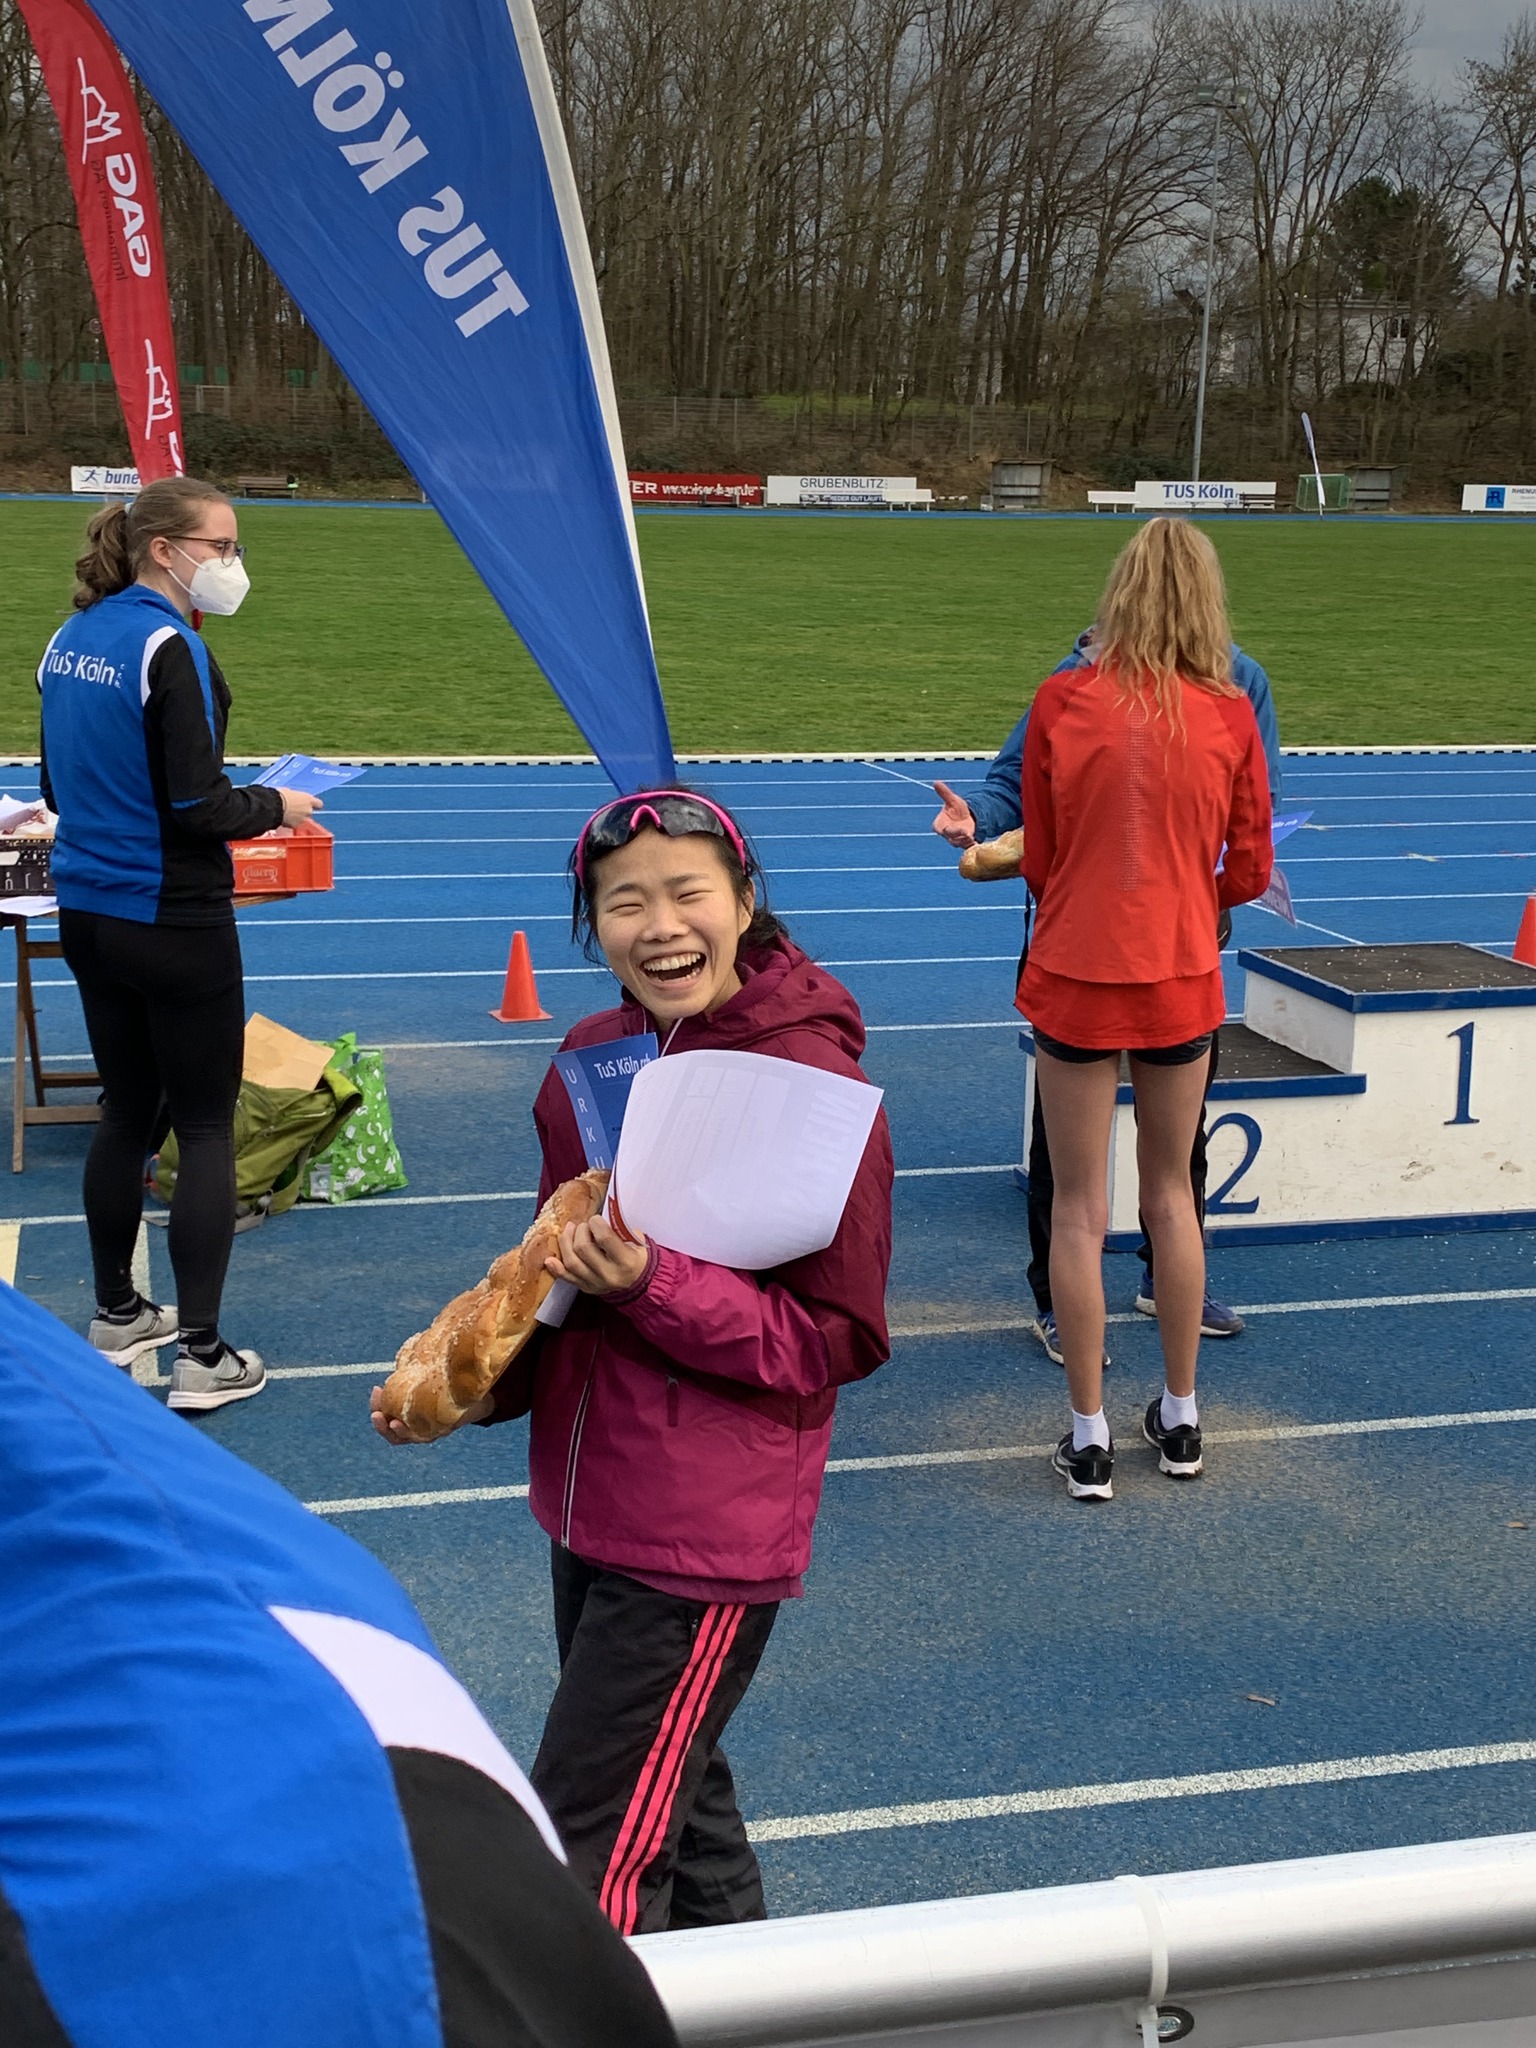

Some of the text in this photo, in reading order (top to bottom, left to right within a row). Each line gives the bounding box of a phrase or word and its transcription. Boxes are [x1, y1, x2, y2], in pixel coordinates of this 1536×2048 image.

[629, 480, 658, 494] ER
[800, 478, 884, 489] GRUBENBLITZ
[1162, 484, 1234, 498] TUS Köln
[47, 649, 115, 686] TuS Köln
[593, 1060, 617, 1079] TuS
[616, 1056, 640, 1076] Köln
[1444, 1021, 1480, 1125] 1
[1206, 1112, 1263, 1215] 2
